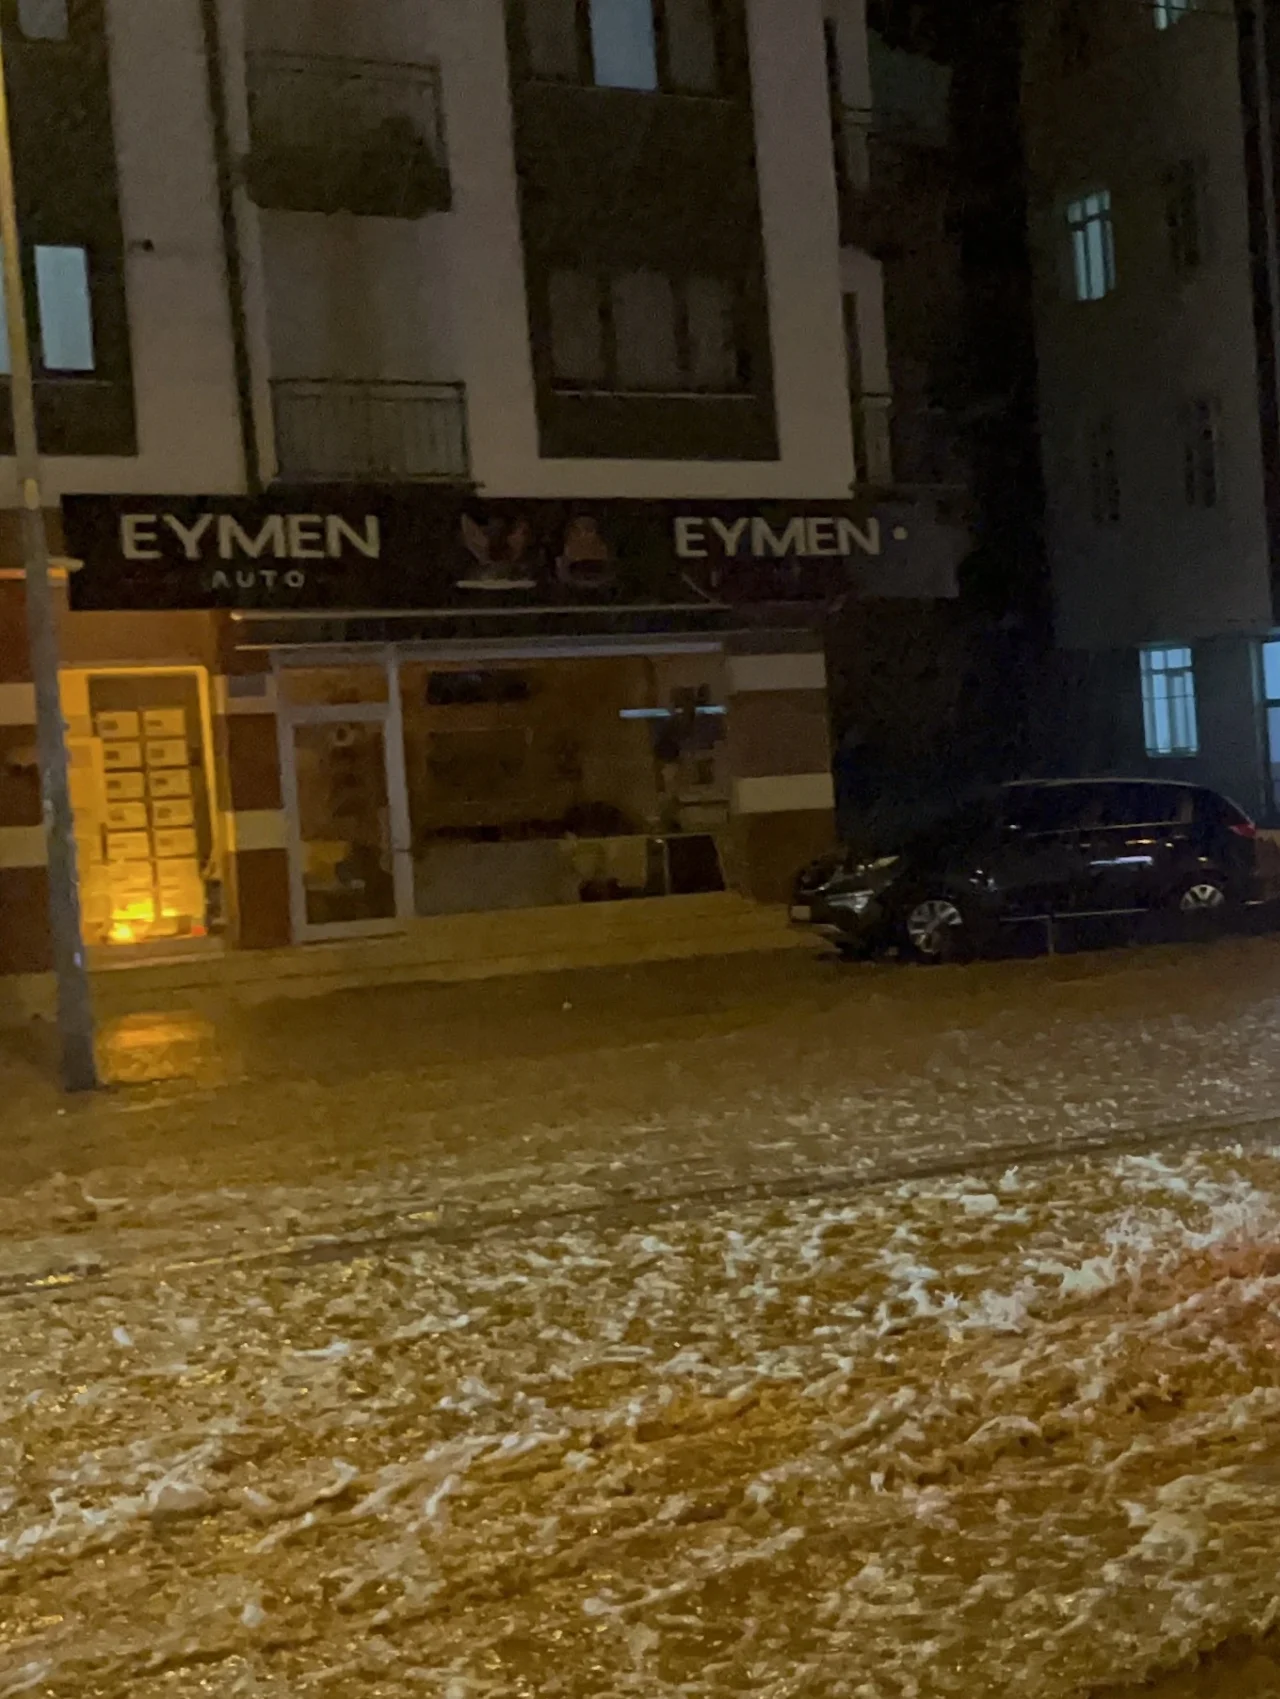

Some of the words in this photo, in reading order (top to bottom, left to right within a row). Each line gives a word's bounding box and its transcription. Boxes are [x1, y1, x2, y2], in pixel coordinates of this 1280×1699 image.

[120, 513, 380, 559] EYMEN
[674, 516, 880, 557] EYMEN
[211, 570, 305, 589] AUTO
